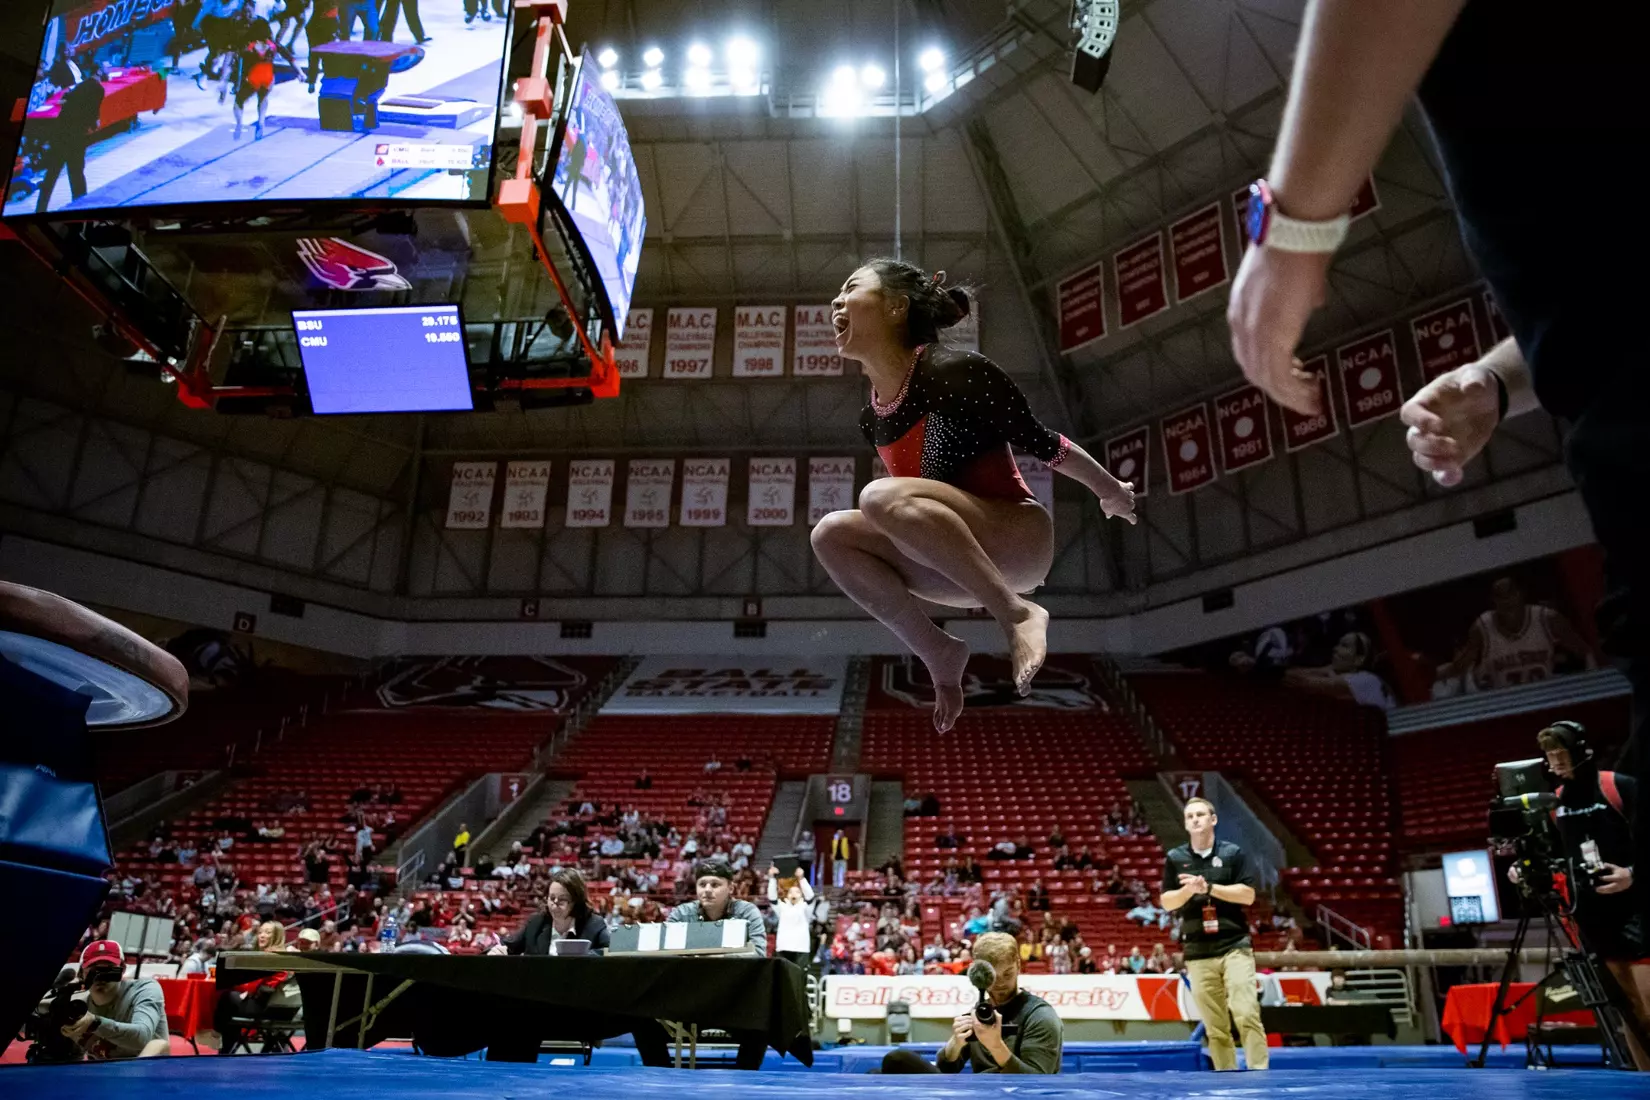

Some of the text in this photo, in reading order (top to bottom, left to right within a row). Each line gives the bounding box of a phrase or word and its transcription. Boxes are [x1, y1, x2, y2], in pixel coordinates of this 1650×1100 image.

[296, 320, 322, 331] BSU
[1417, 311, 1471, 340] NCAA
[300, 336, 328, 347] CMU
[797, 355, 841, 370] 1999
[1340, 342, 1393, 372] NCAA
[669, 359, 709, 373] 1997
[1217, 392, 1263, 419] NCAA
[1356, 388, 1393, 413] 1989
[1164, 413, 1205, 439] NCAA
[1110, 439, 1144, 460] NAIA
[1231, 437, 1263, 460] 1981
[453, 468, 495, 480] NCAA
[508, 467, 548, 478] NCAA
[570, 466, 613, 478] NCAA
[630, 465, 672, 477] NCAA
[685, 465, 728, 477] NCAA
[751, 464, 793, 475] NCAA
[810, 463, 855, 475] NCAA
[453, 511, 485, 523] 1992
[573, 509, 605, 521] 1994
[753, 508, 788, 519] 2000
[525, 604, 536, 616] C
[240, 618, 249, 630] D
[658, 668, 824, 678] BALL
[626, 678, 837, 690] STATE
[827, 783, 852, 802] 18
[1178, 780, 1200, 799] 17
[835, 986, 893, 1006] Ball
[899, 986, 977, 1006] State
